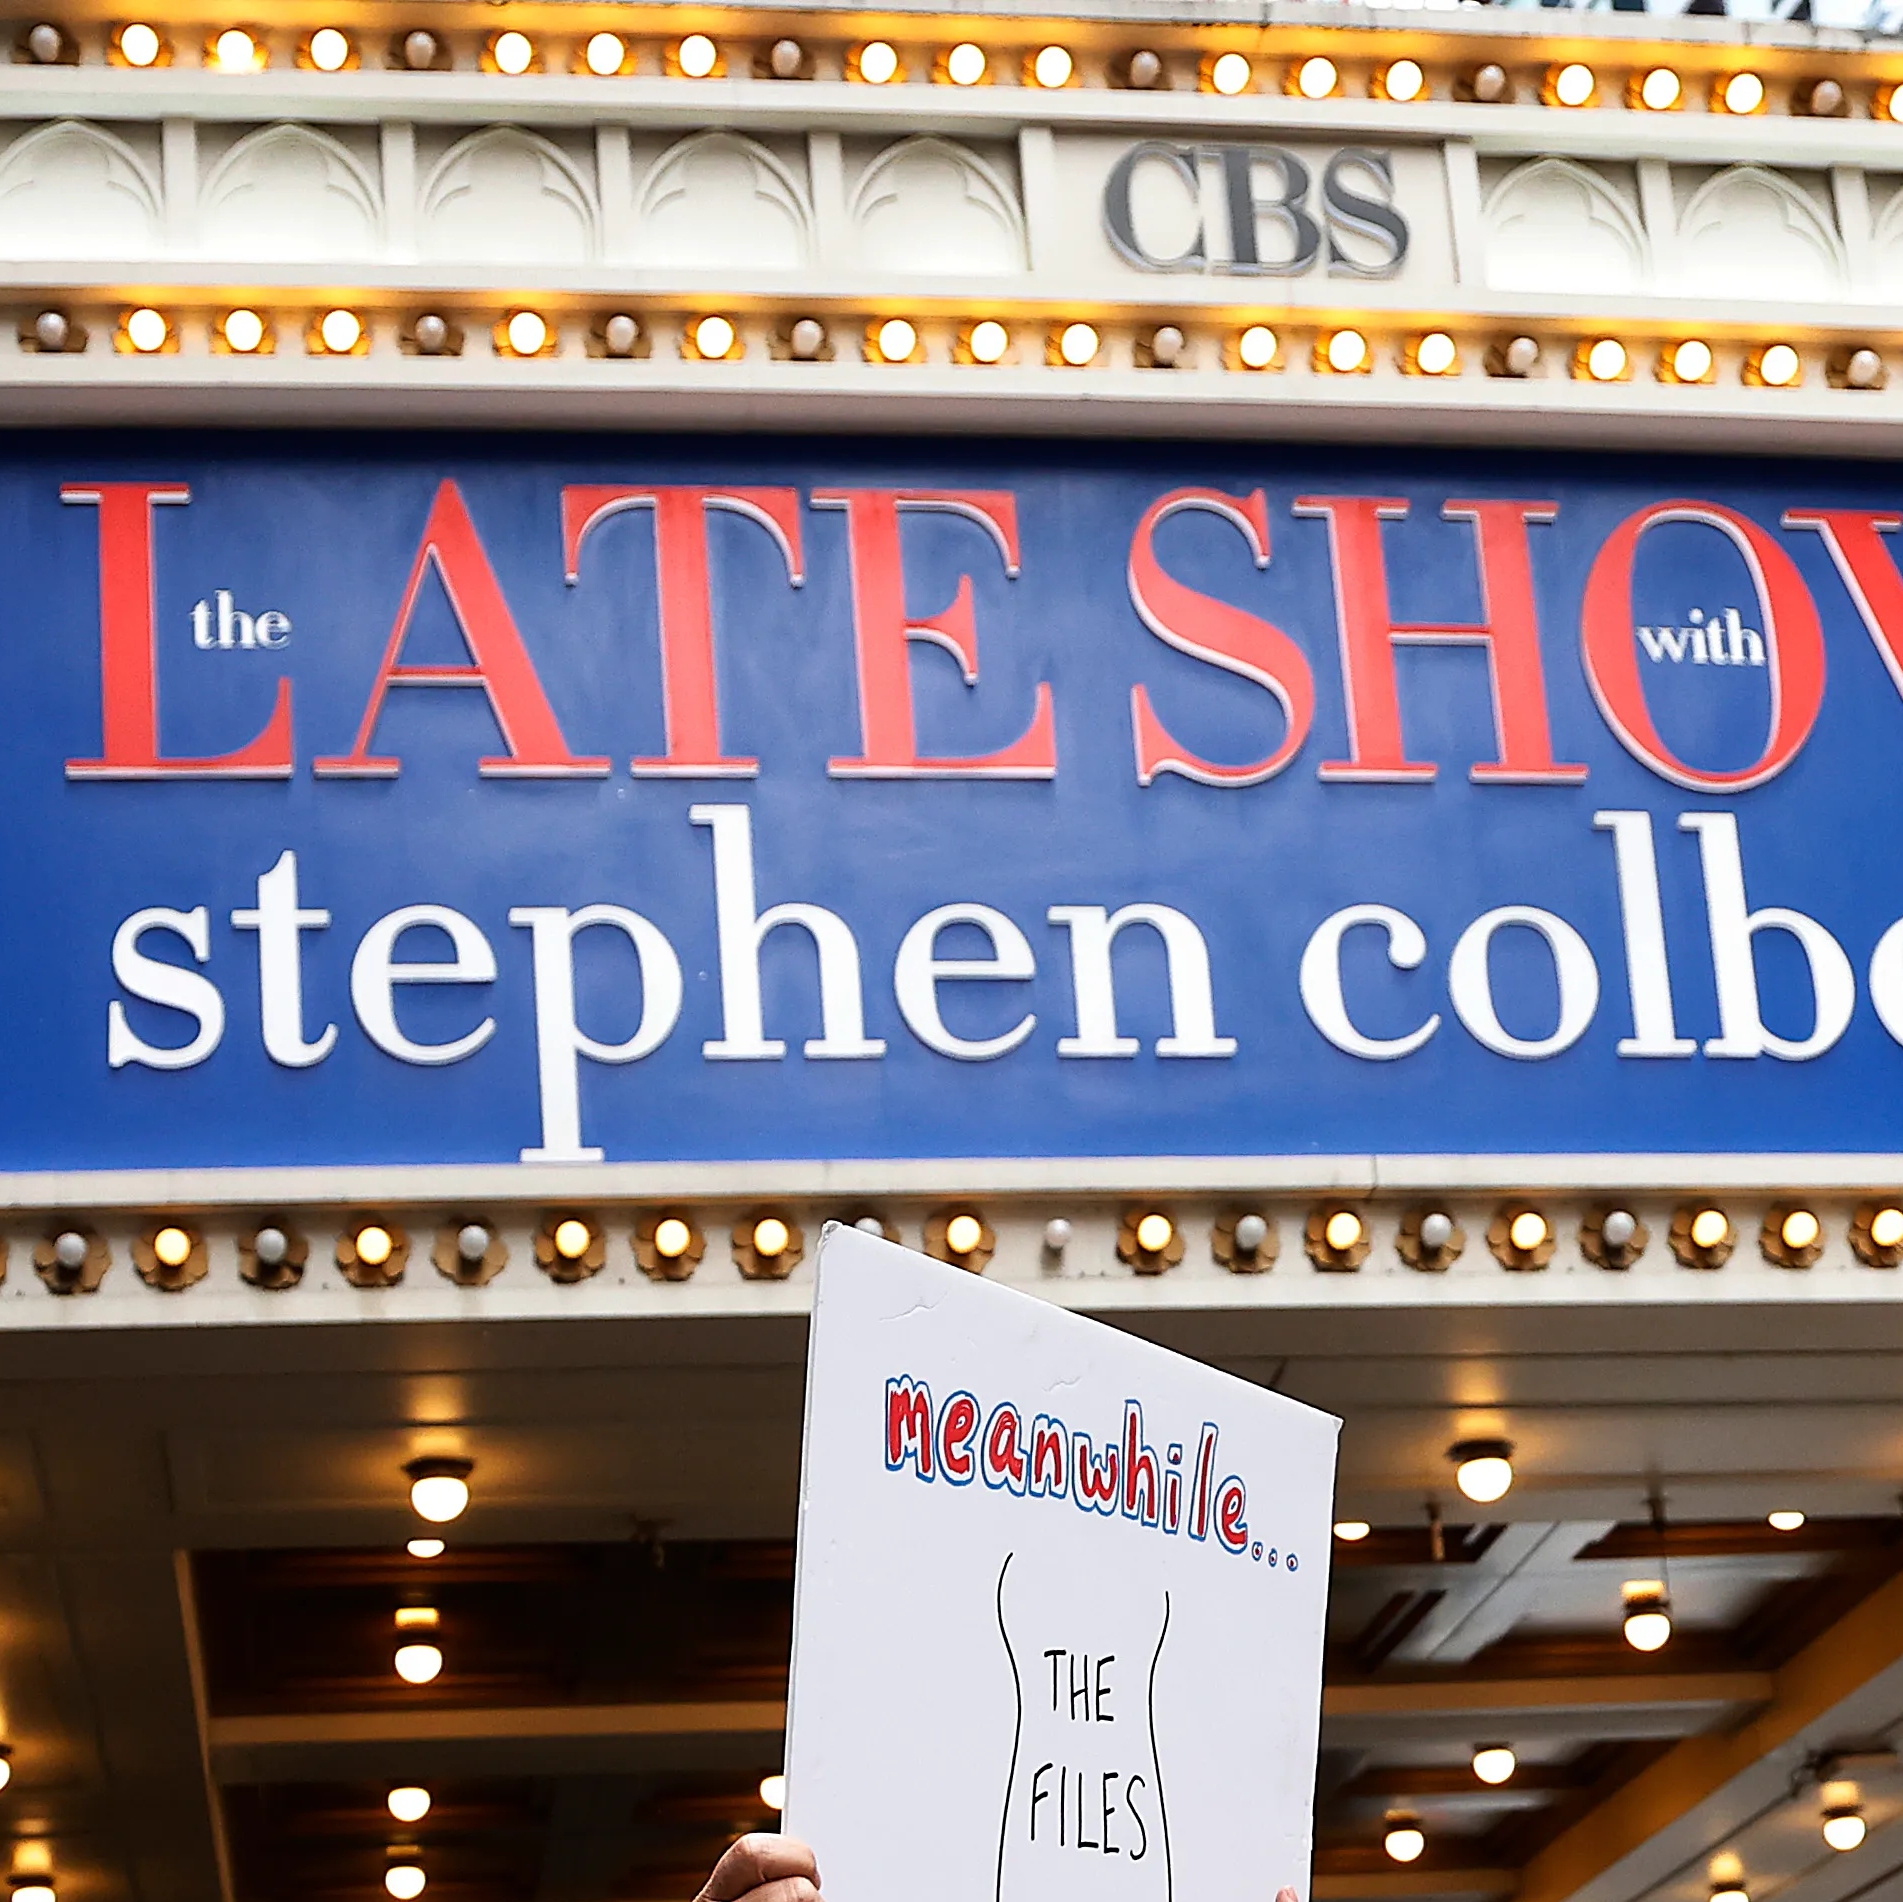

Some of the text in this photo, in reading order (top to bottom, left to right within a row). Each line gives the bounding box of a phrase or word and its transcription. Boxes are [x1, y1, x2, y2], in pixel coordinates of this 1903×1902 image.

[1102, 140, 1411, 278] CBS
[57, 478, 1057, 781] LATE
[189, 591, 293, 651] the
[1636, 609, 1767, 669] with
[106, 803, 1237, 1165] stephen
[884, 1373, 1301, 1573] meanwhile...
[1043, 1649, 1116, 1724] THE
[1028, 1763, 1148, 1862] FILES
